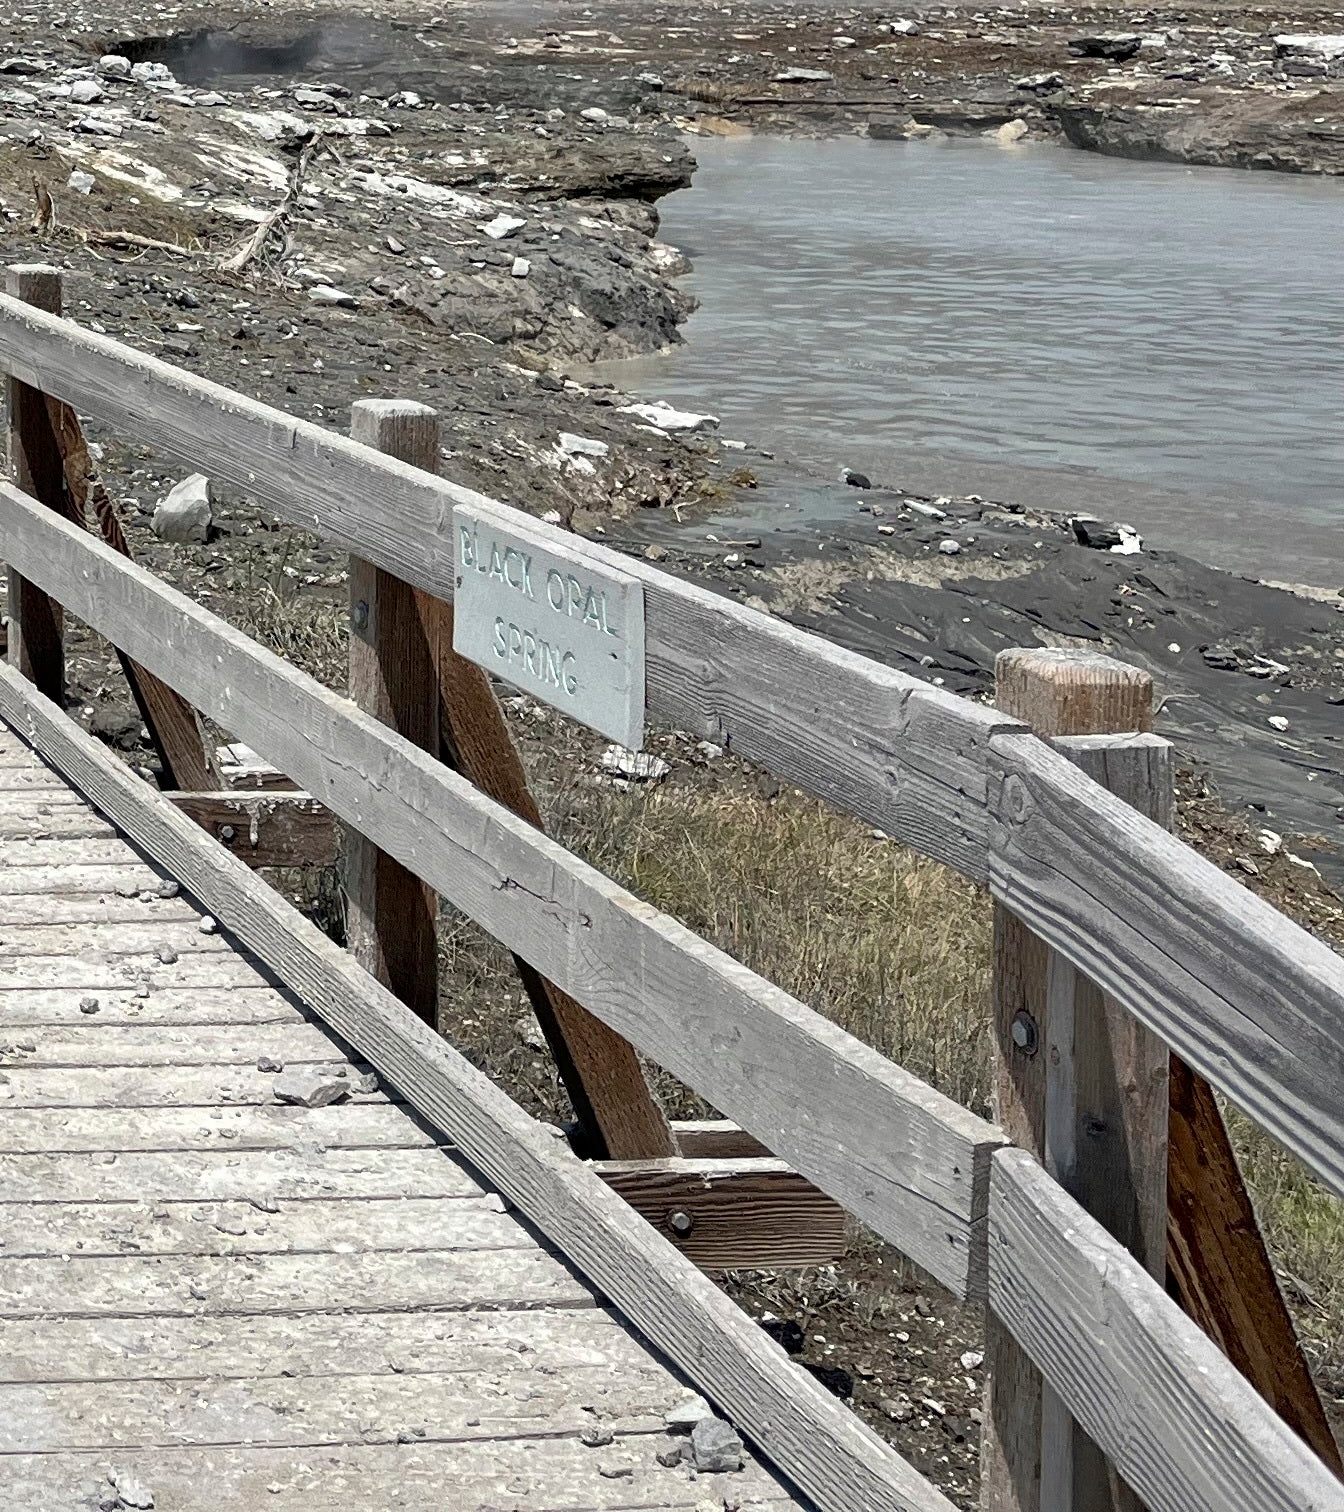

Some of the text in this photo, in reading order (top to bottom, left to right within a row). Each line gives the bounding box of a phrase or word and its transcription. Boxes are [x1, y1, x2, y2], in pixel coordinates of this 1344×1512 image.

[459, 524, 617, 637] BLACK OPAL
[492, 615, 578, 696] SPRING
